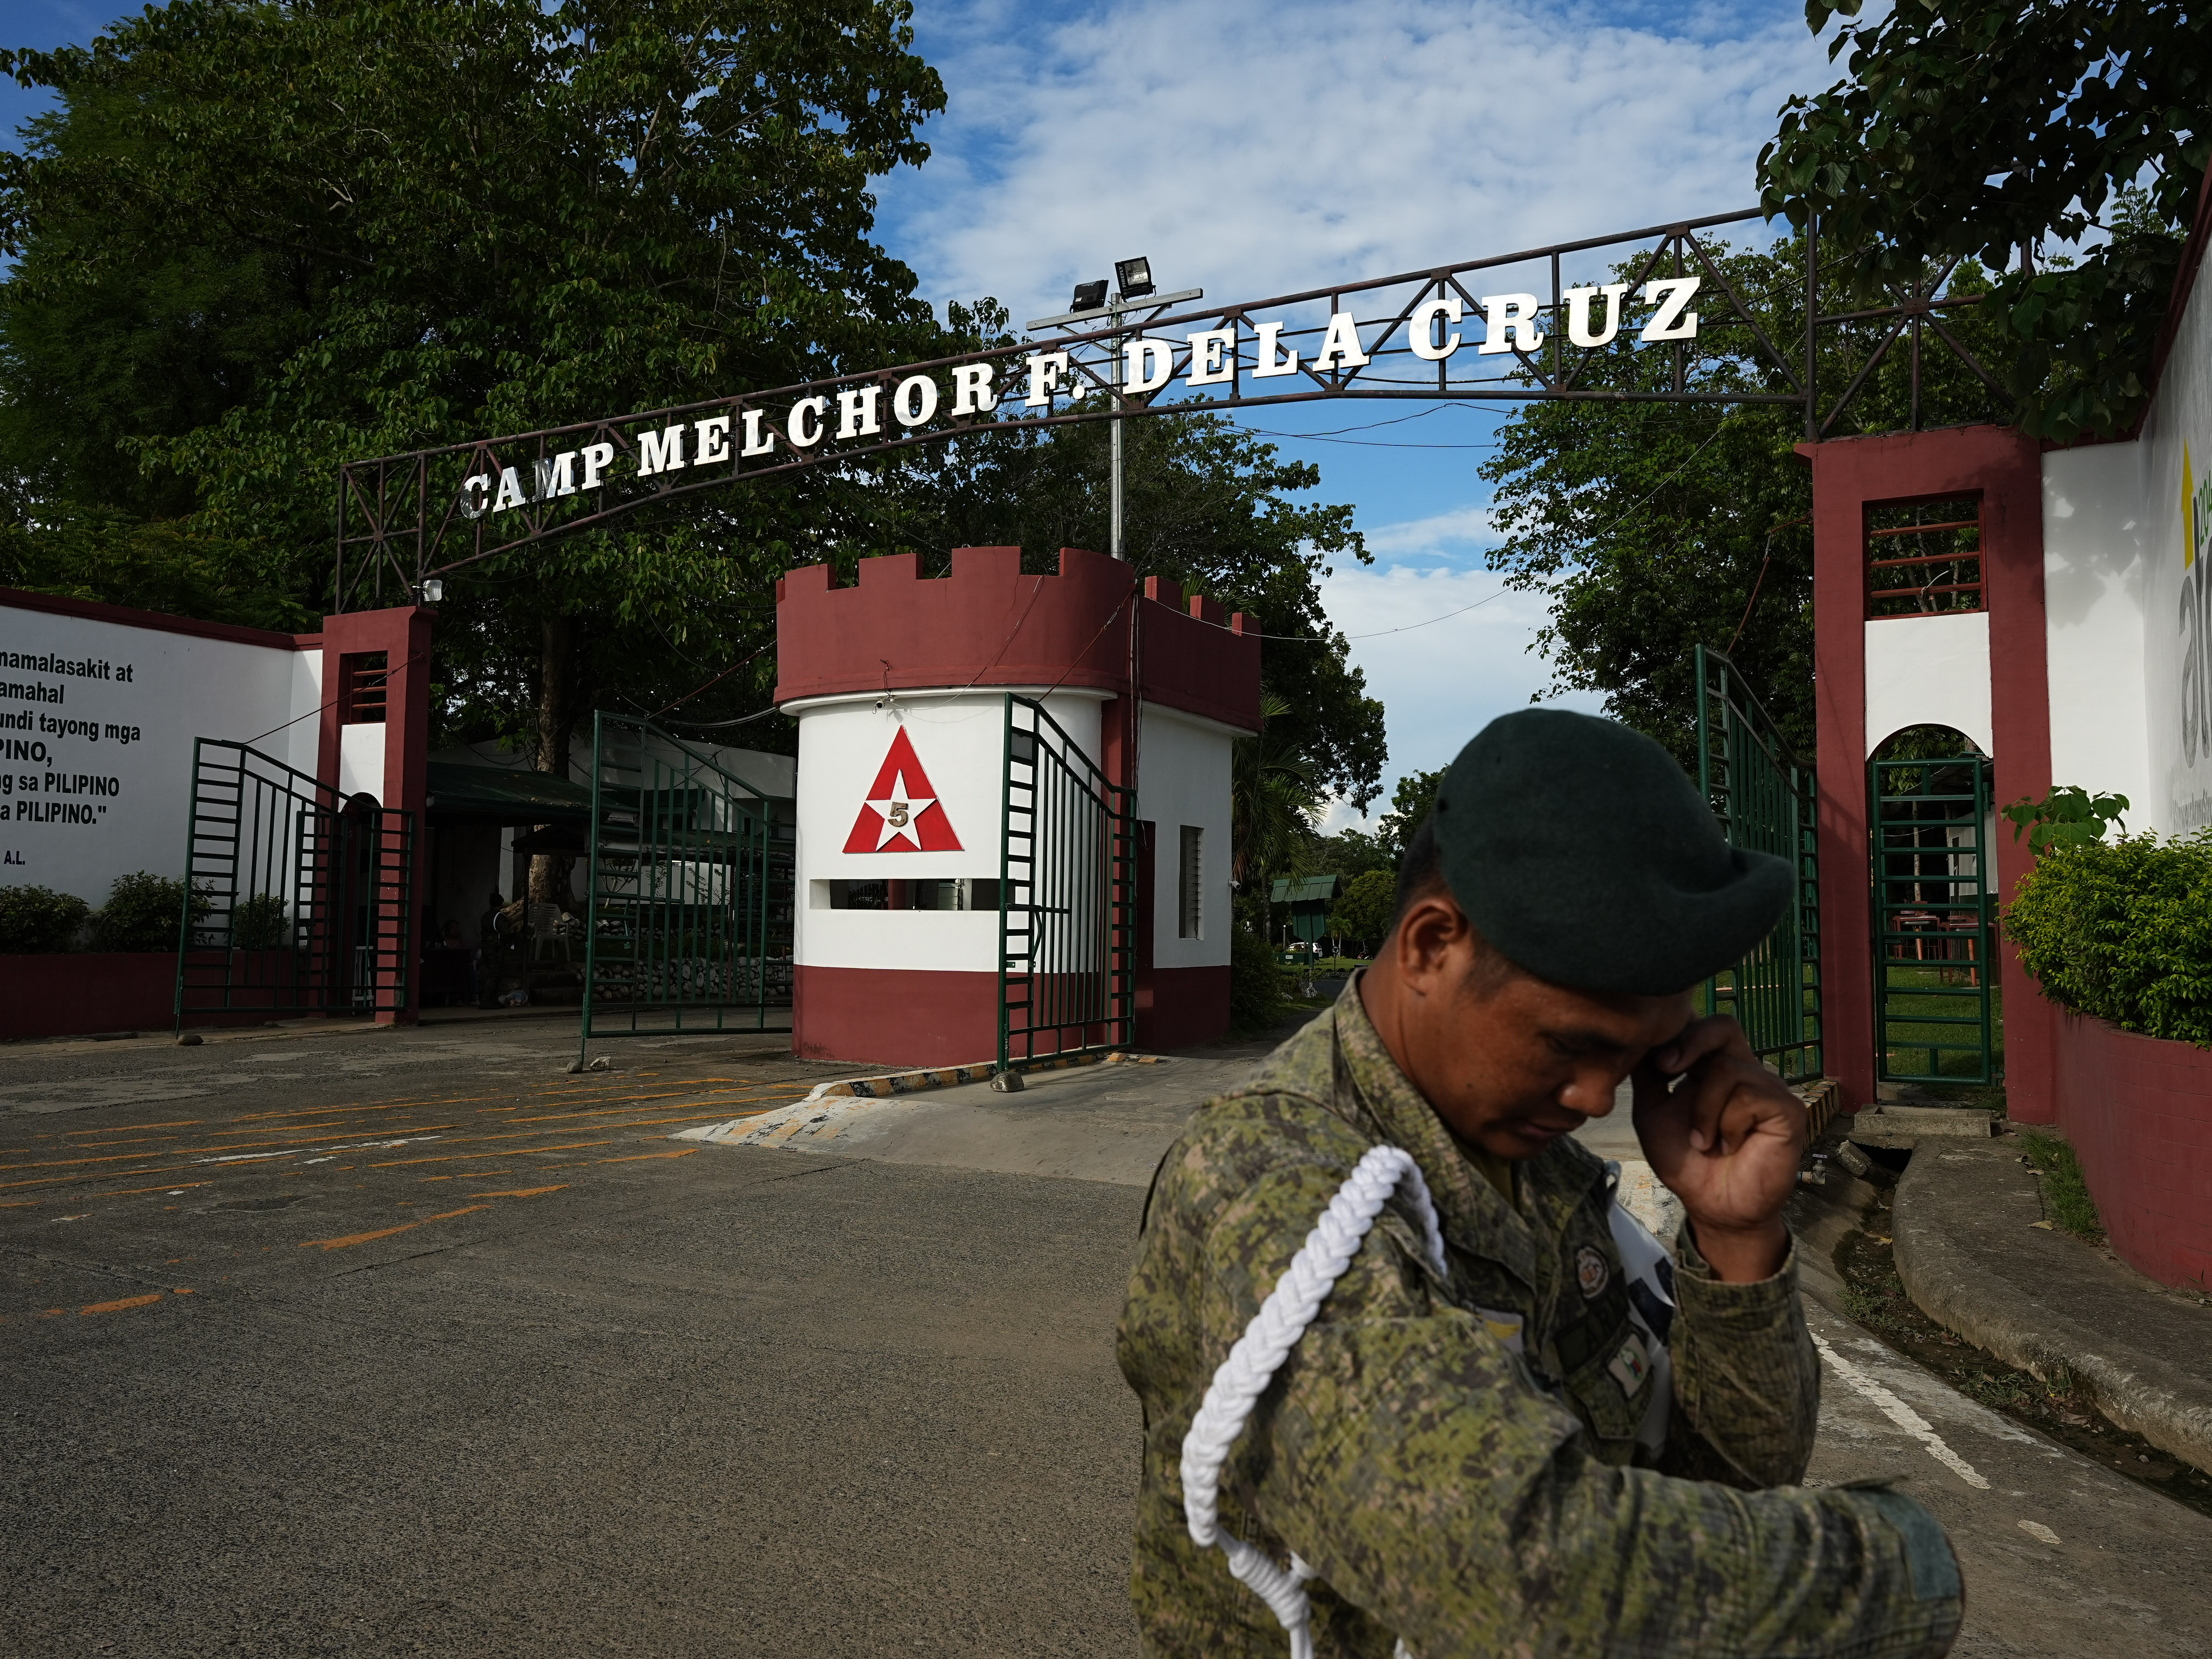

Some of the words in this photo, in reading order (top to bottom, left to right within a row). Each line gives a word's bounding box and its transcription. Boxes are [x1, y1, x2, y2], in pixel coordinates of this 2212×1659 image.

[1118, 266, 1127, 288] FIREFLY
[461, 442, 615, 520] CAMP
[637, 363, 999, 476] MELCHOR
[1025, 352, 1085, 407] F.
[1123, 312, 1370, 395] DELA
[1408, 276, 1701, 361] CRUZ
[116, 664, 133, 683] at
[0, 681, 64, 704] amahal
[39, 712, 99, 742] tayong
[105, 724, 140, 745] mga
[0, 774, 13, 795] g
[18, 775, 38, 792] sa
[44, 772, 119, 797] PILIPINO
[16, 800, 107, 825] PILIPINO."
[887, 801, 908, 827] 5
